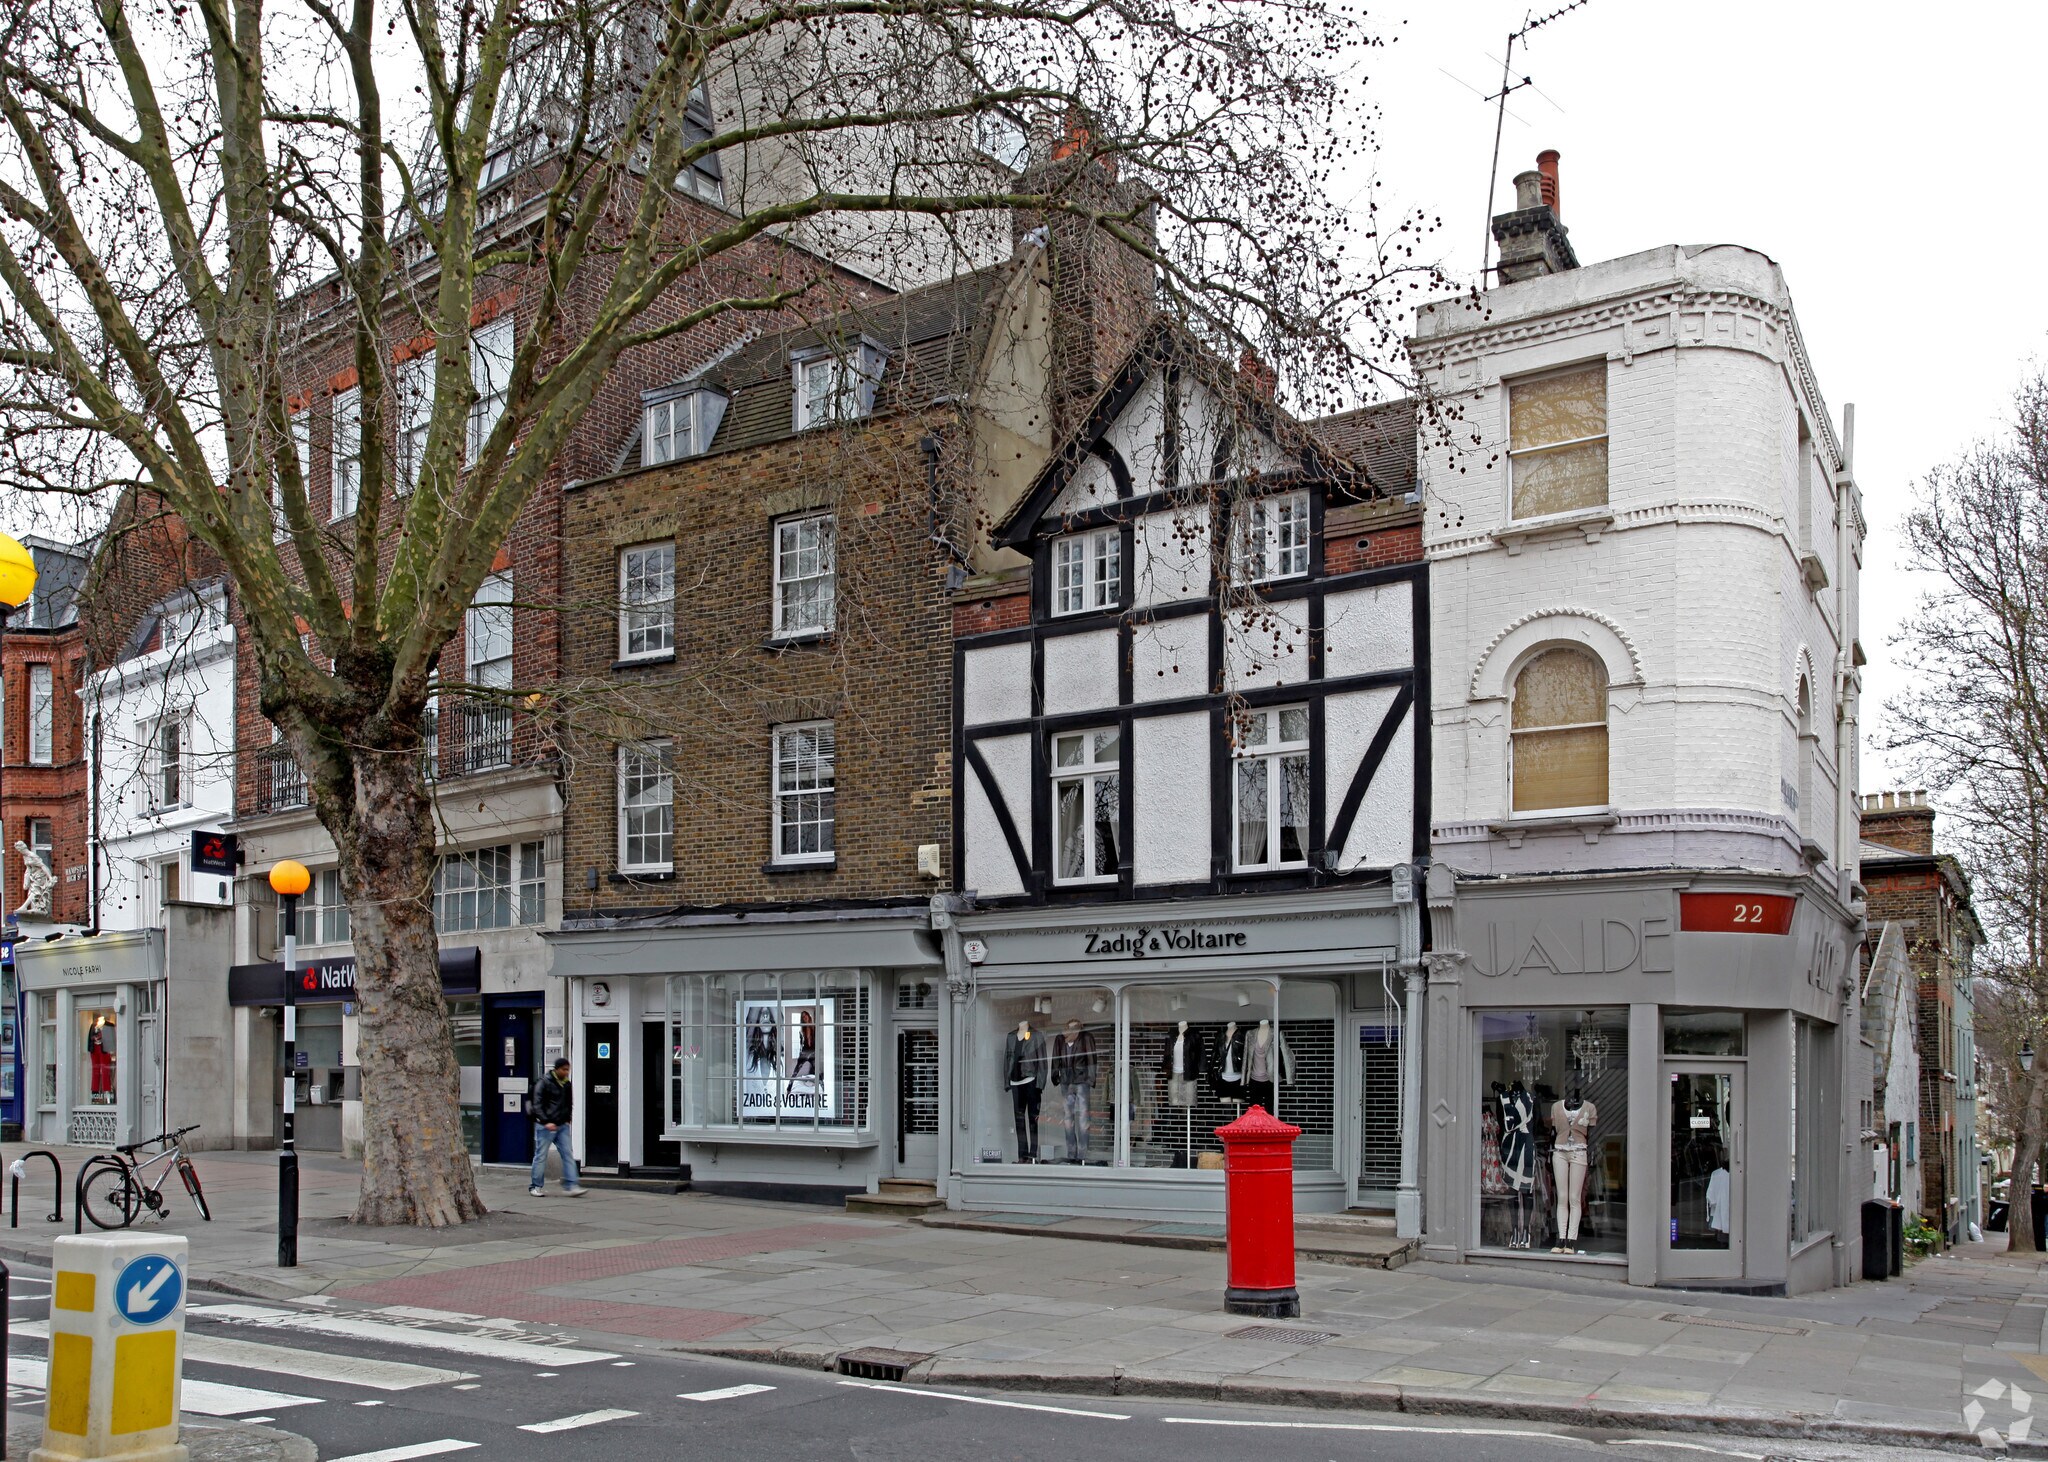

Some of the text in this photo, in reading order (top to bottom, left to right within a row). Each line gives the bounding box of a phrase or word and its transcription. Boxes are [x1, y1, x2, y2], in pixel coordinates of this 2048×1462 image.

[203, 858, 226, 867] NatWest
[1733, 904, 1763, 923] 22
[1084, 928, 1247, 957] Zadig & Voltaire
[1472, 917, 1673, 977] JAIDE
[62, 964, 102, 976] NICOLE FARHI
[743, 1093, 772, 1108] ZADIG
